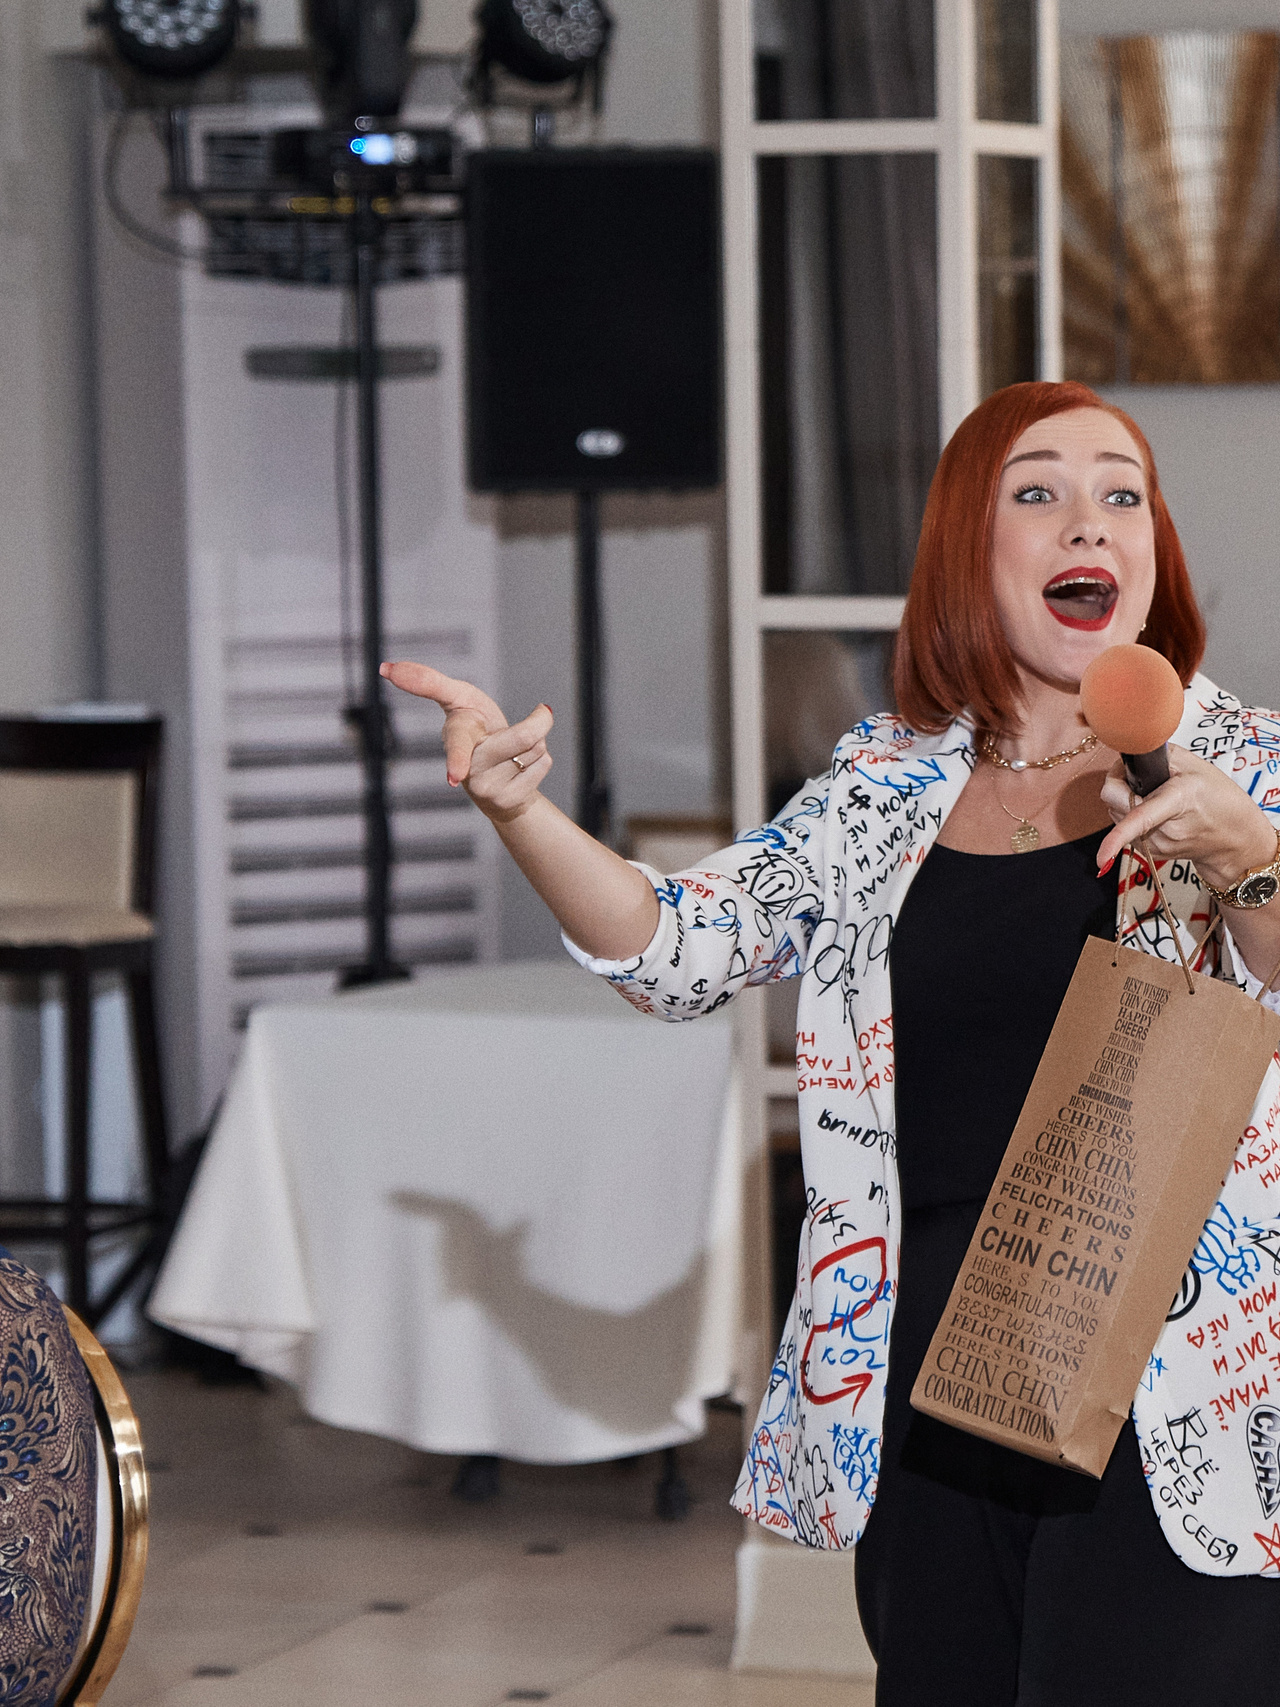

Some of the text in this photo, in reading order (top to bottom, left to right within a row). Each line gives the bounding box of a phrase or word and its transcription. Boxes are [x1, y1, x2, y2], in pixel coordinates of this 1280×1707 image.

[1120, 991, 1164, 1017] CHIN CHIN
[1123, 976, 1171, 1005] BEST WISHES
[1114, 1018, 1149, 1041] CHEERS
[1118, 1006, 1155, 1028] HAPPY
[1094, 1058, 1138, 1084] CHIN CHIN
[1101, 1046, 1141, 1069] CHEERS
[1078, 1084, 1133, 1113] CONGRATULATIONS
[1109, 1079, 1119, 1091] TO
[1118, 1082, 1132, 1097] YOU
[1058, 1107, 1136, 1145] CHEERS
[1068, 1095, 1134, 1127] BEST WISHES
[1035, 1131, 1137, 1184] CHIN CHIN
[1090, 1134, 1107, 1149] TO
[1111, 1140, 1138, 1160] YOU
[1010, 1163, 1138, 1220] BEST WISHES
[1022, 1151, 1137, 1200] CONGRATULATIONS
[1000, 1182, 1132, 1241] FELICITATIONS
[980, 1226, 1118, 1297] CHIN CHIN
[964, 1273, 1099, 1337] CONGRATULATIONS
[1040, 1277, 1061, 1298] TO
[1072, 1291, 1104, 1315] YOU
[951, 1313, 1082, 1373] FELICITATIONS
[957, 1295, 1087, 1355] BEST WISHES
[936, 1346, 1068, 1414] CHIN CHIN
[1009, 1353, 1029, 1371] TO
[1035, 1364, 1073, 1387] YOU
[924, 1374, 1059, 1443] CONGRATULATIONS
[1183, 1514, 1239, 1567] СЕБЯ
